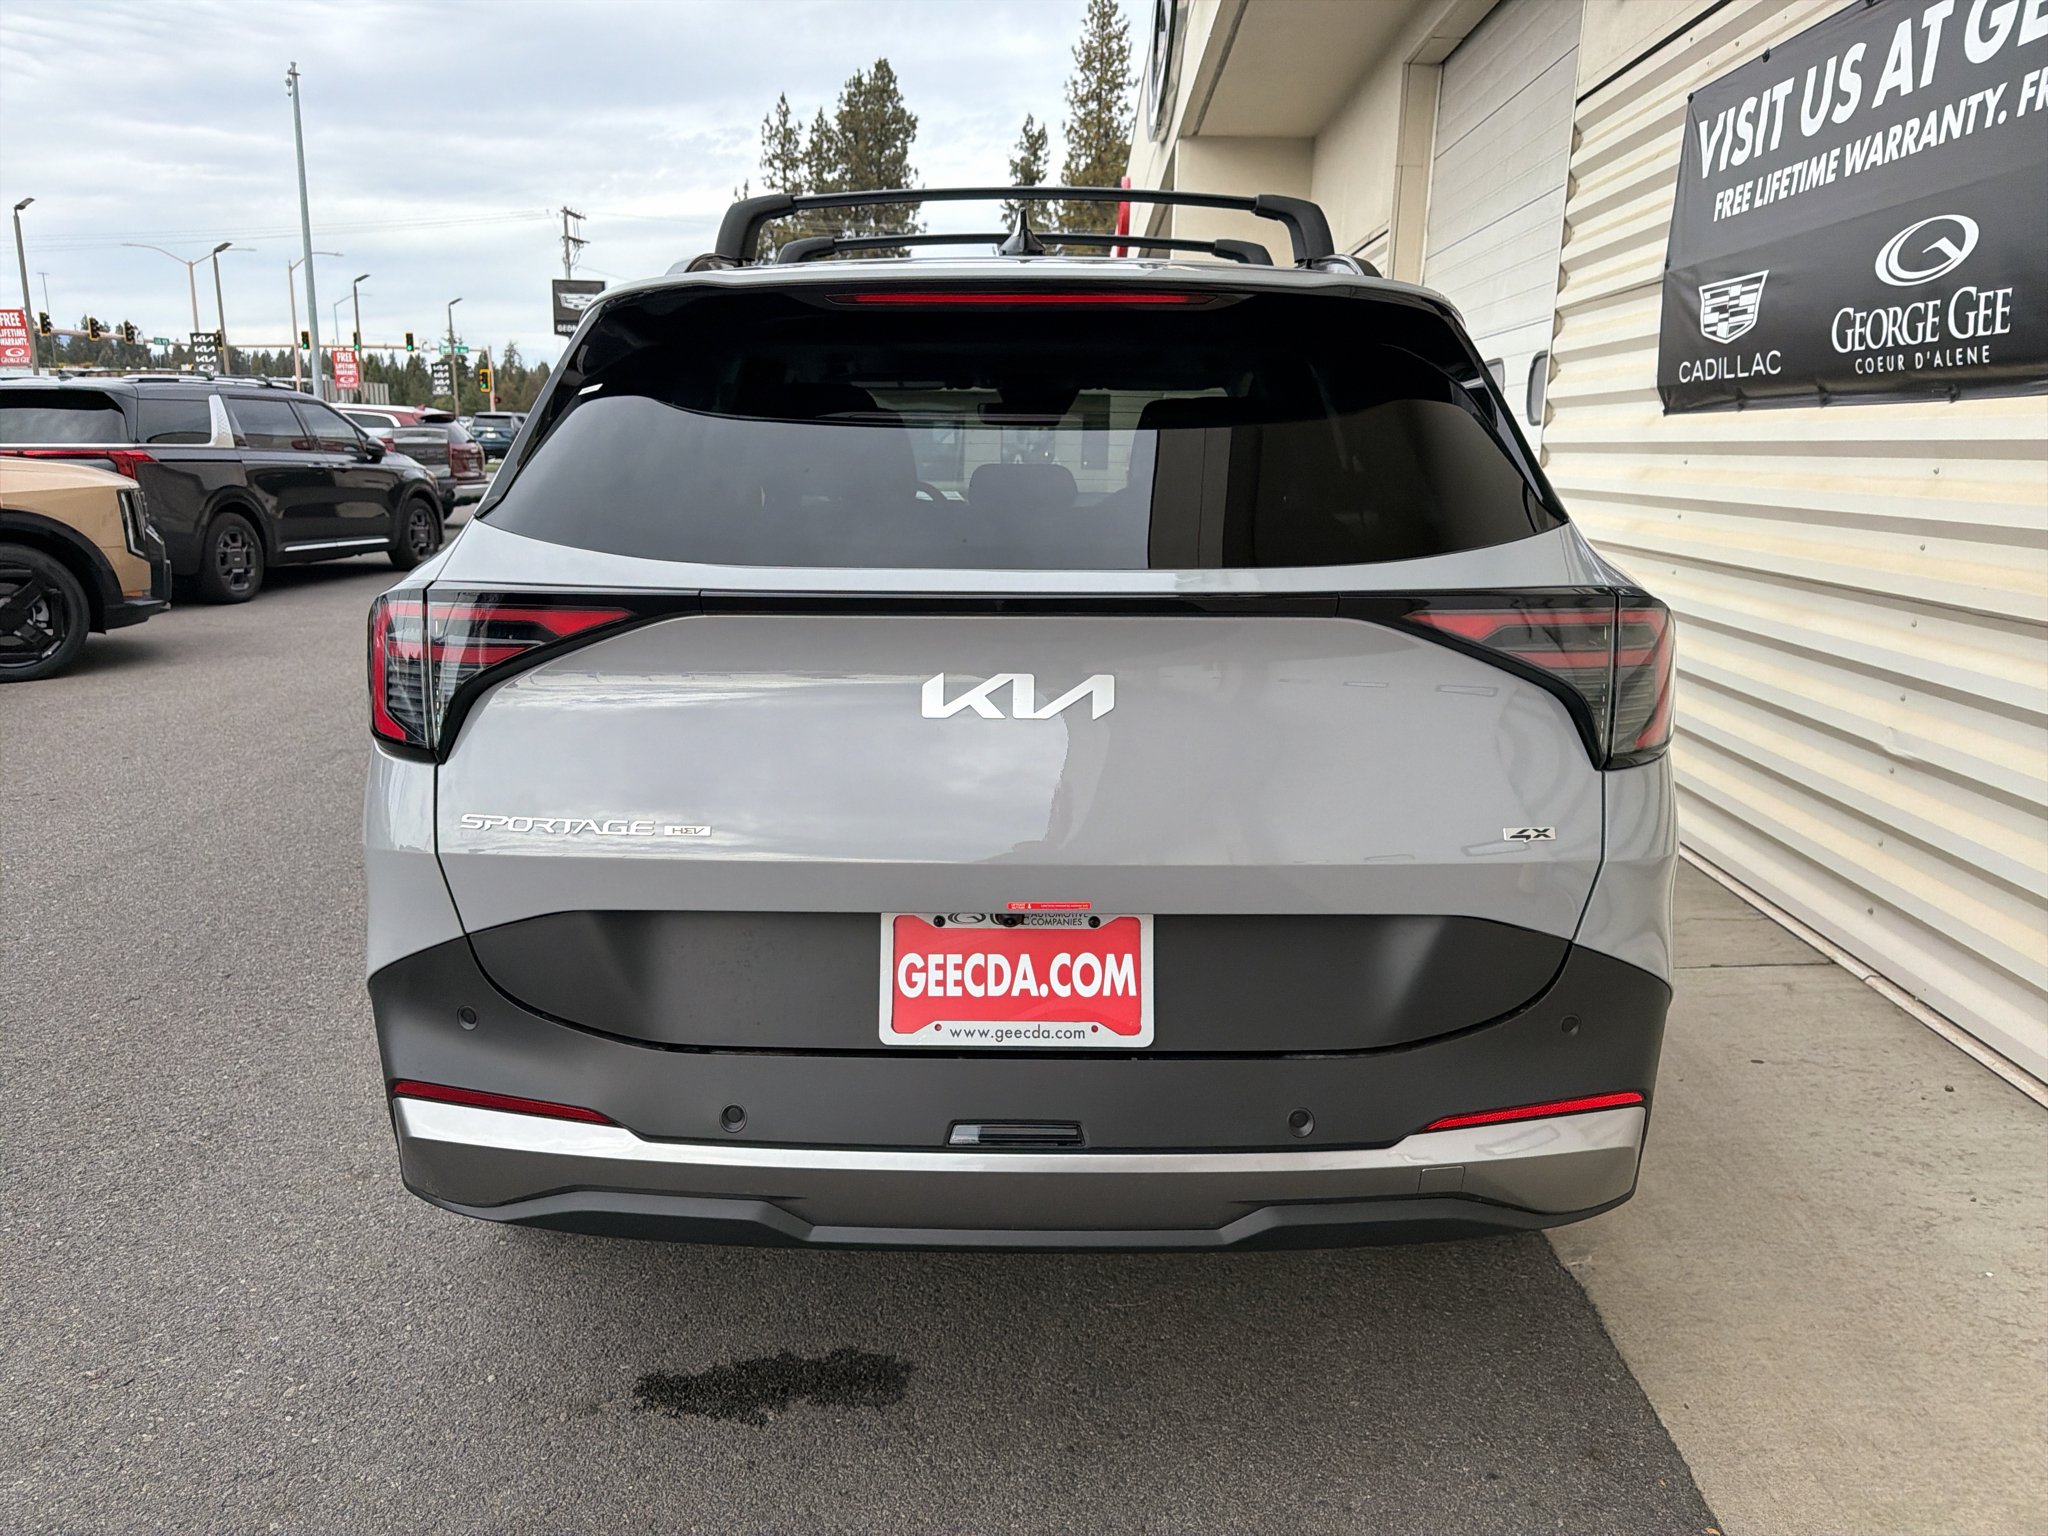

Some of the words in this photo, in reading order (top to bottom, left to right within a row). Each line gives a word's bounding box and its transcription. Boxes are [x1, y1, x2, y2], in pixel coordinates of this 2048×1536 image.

[1699, 76, 1795, 179] VISIT
[1800, 42, 1867, 137] US
[1871, 2, 1955, 109] AT
[1713, 184, 1753, 222] FREE
[1753, 147, 1841, 207] LIFETIME
[1844, 82, 2009, 178] WARRANTY.
[1831, 299, 1941, 353] GEORGE
[1947, 286, 2013, 340] GEE
[1678, 350, 1782, 383] CADILLAC
[1855, 353, 1905, 375] COEUR
[1915, 345, 1991, 370] D'ALENE
[922, 672, 1115, 721] KIA
[460, 813, 655, 836] SPORTAGE
[1031, 917, 1083, 926] COMPANIES
[898, 952, 1137, 998] GEECDA.COM
[950, 1024, 1085, 1042] www.geecda.com
